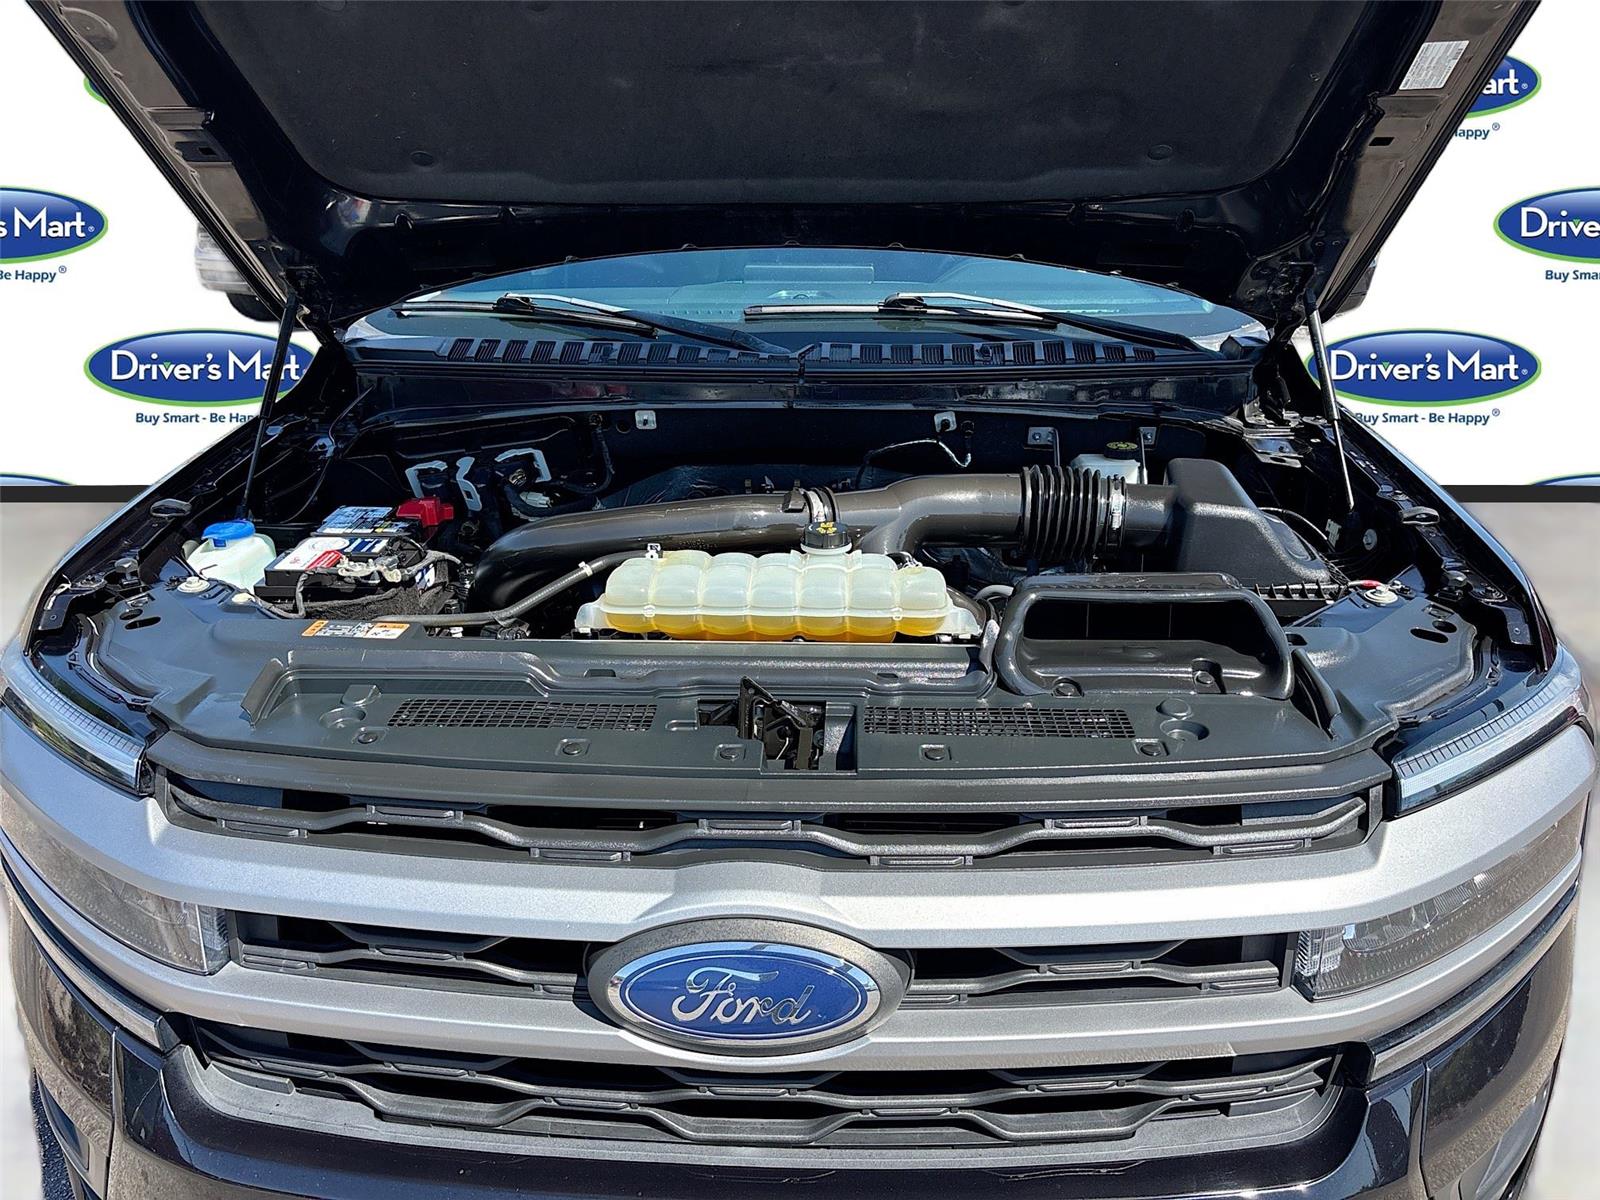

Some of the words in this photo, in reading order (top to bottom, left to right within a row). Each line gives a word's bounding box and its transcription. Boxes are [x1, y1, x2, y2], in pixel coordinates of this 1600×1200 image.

[1482, 69, 1520, 94] art
[1455, 128, 1490, 140] appy
[14, 207, 86, 237] Mart
[15, 270, 56, 282] Happy
[1545, 270, 1569, 282] Buy
[1573, 270, 1600, 280] Sma
[111, 349, 222, 380] Driver's
[1330, 349, 1441, 380] Driver's
[1447, 349, 1519, 380] Mart
[136, 413, 160, 425] Buy
[163, 412, 199, 423] Smart
[210, 413, 226, 423] Be
[1382, 412, 1418, 423] Smart
[1429, 413, 1445, 423] Be
[1448, 413, 1490, 425] Happy
[671, 966, 814, 1025] Ford
